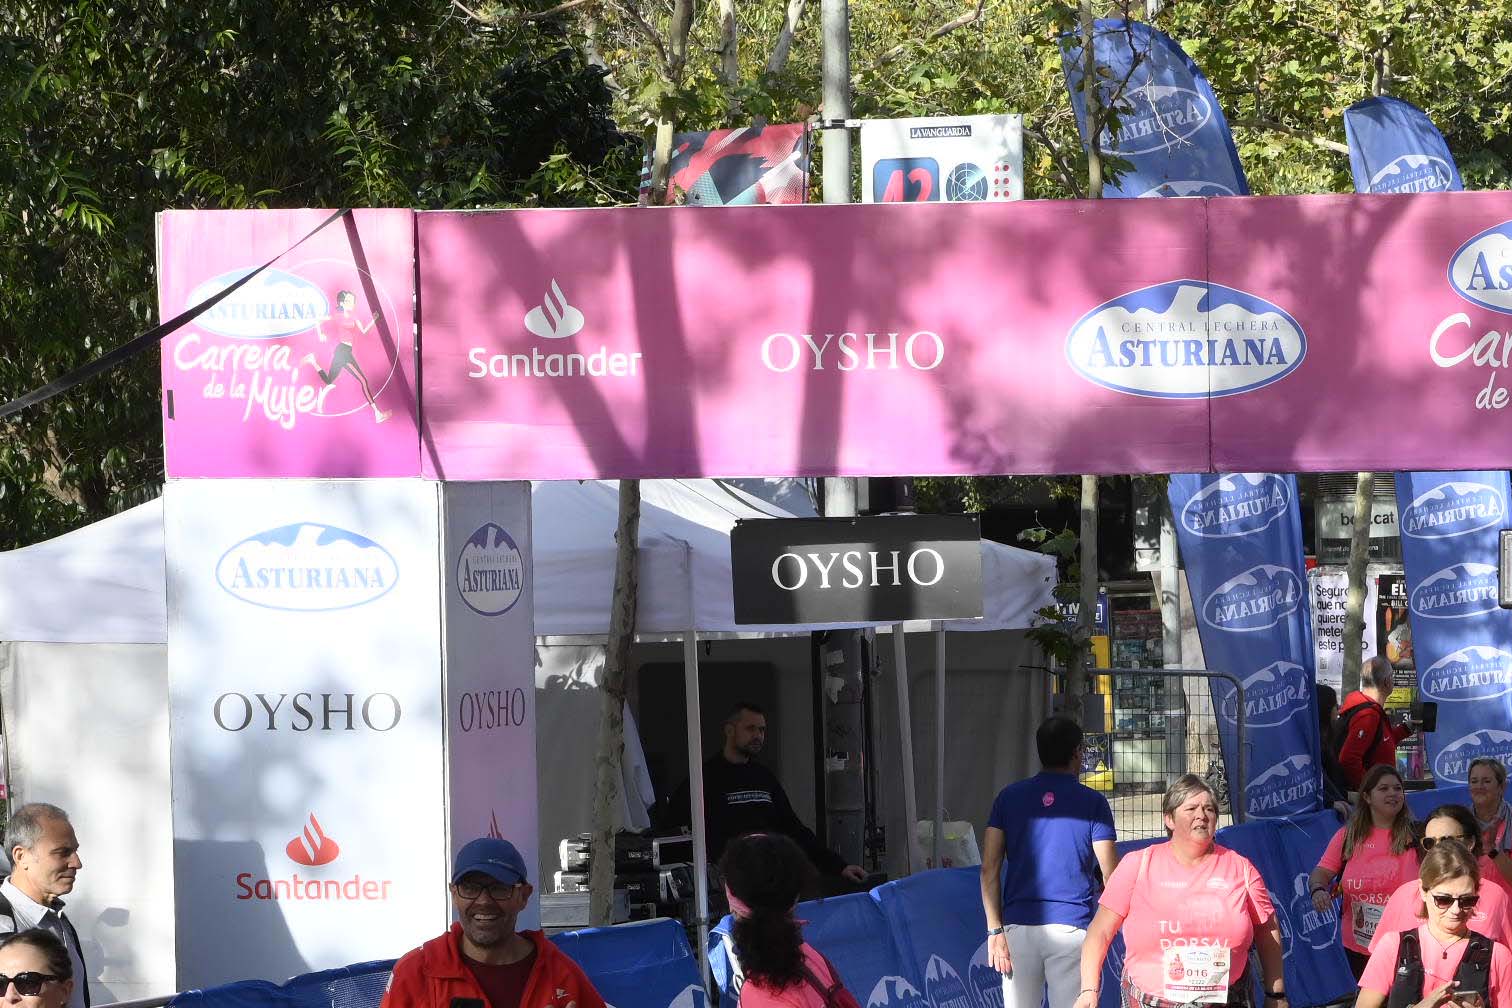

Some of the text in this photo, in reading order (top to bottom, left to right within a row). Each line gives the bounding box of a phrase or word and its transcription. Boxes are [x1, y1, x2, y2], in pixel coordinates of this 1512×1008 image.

[922, 126, 971, 138] VANGUARDIA
[1121, 319, 1280, 333] CENTRAL LECHERA
[173, 334, 292, 371] Carrera
[468, 346, 642, 378] Santander
[761, 331, 944, 373] OYSHO
[1087, 326, 1289, 367] ASTURIANA
[203, 375, 225, 399] de
[243, 368, 336, 429] Mujer
[1475, 373, 1509, 409] de
[231, 556, 385, 590] ASTURIANA
[462, 563, 520, 594] ASTURIANA
[771, 548, 944, 590] OYSHO
[214, 692, 402, 732] OYSHO
[460, 687, 526, 732] OYSHO
[236, 873, 392, 900] Santander
[1347, 879, 1362, 890] TU
[1160, 920, 1181, 934] TU
